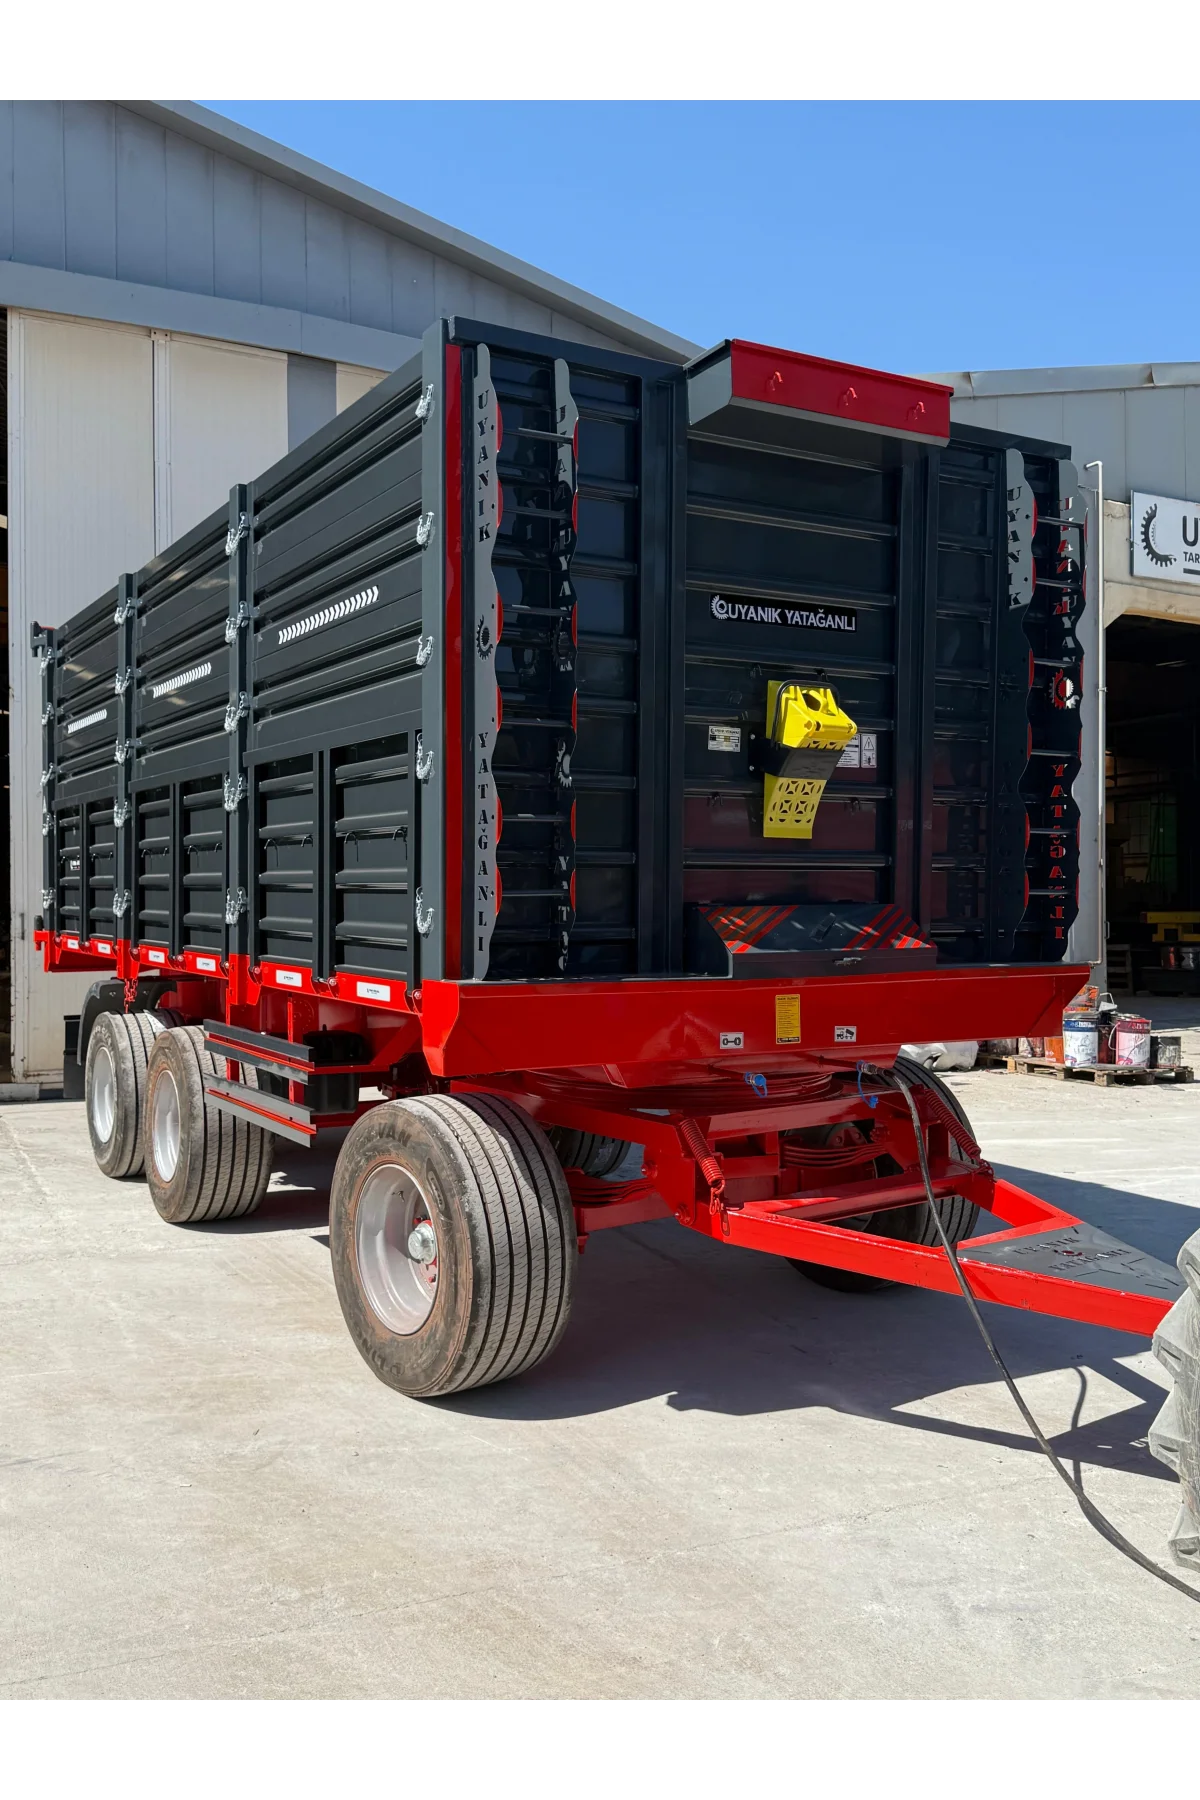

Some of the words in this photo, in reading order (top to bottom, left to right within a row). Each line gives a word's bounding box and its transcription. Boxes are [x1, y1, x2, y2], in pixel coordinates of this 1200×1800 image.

[477, 388, 491, 543] UYANIK
[1182, 515, 1200, 547] U
[728, 603, 782, 624] UYANIK
[784, 608, 856, 631] YATAĞANLI
[477, 731, 490, 952] YATAĞANLI
